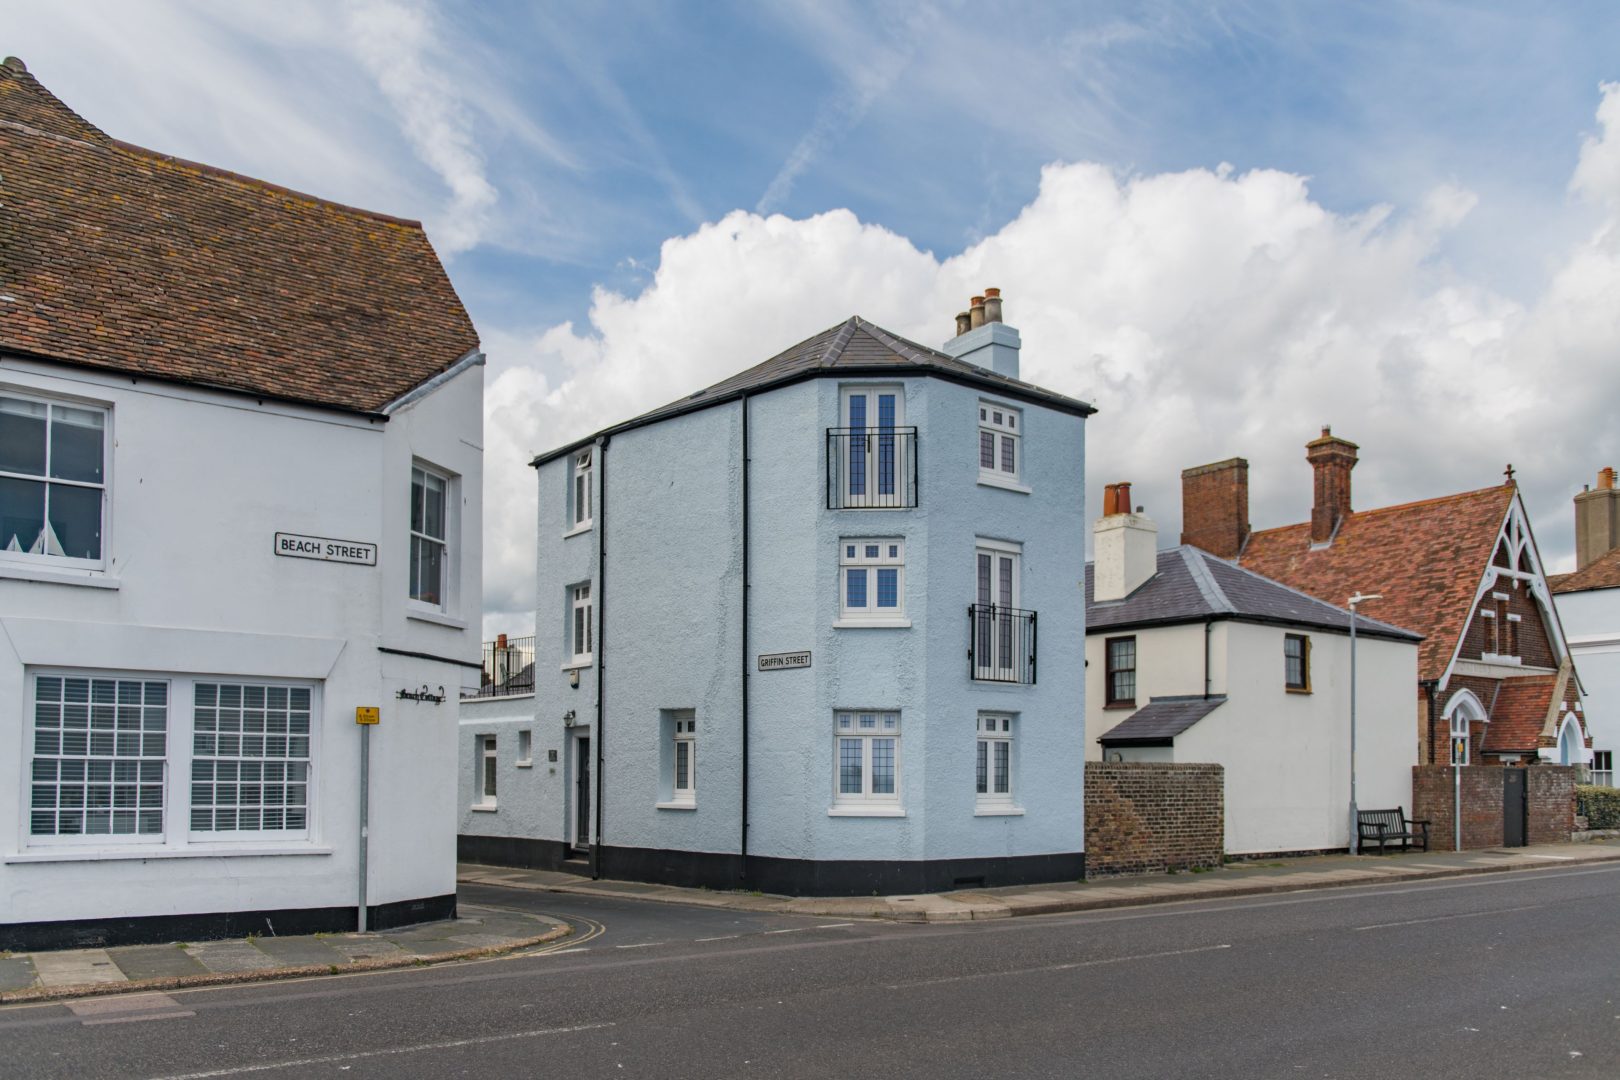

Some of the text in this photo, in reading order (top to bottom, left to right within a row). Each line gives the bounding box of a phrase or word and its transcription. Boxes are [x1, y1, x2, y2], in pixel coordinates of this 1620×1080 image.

[281, 539, 371, 560] BEACH STREET
[760, 655, 809, 667] GRIFFIN STREET
